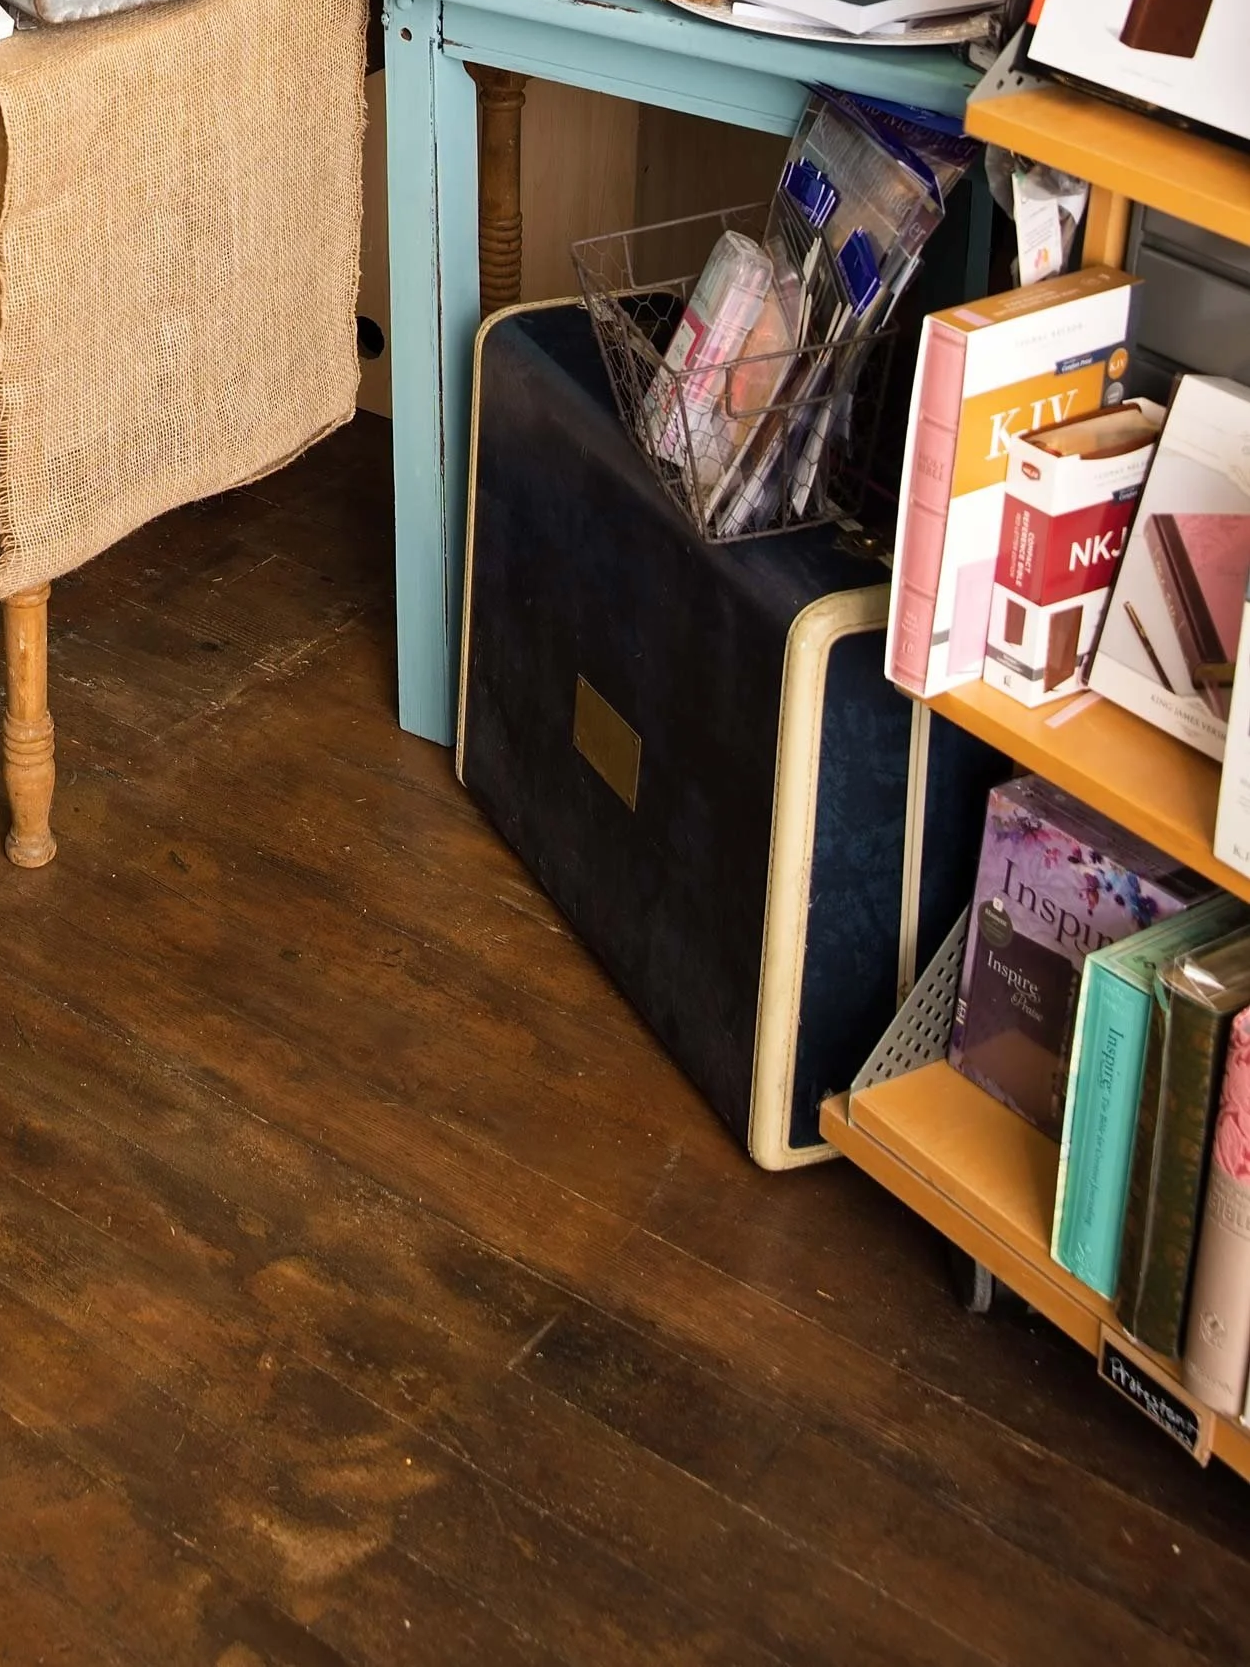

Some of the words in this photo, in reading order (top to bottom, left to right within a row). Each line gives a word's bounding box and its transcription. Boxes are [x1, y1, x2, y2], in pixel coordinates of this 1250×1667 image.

[1109, 359, 1124, 372] KJV
[985, 388, 1078, 460] KJV
[1018, 510, 1030, 560] REFERENCE
[1024, 531, 1035, 574] COMPACT
[1069, 525, 1128, 572] NKJ
[1015, 560, 1025, 587] BIBLE
[1150, 694, 1173, 712] KING
[1174, 706, 1200, 728] JAMES
[987, 950, 1042, 1003] Inspire
[1100, 1027, 1125, 1092] Inspire
